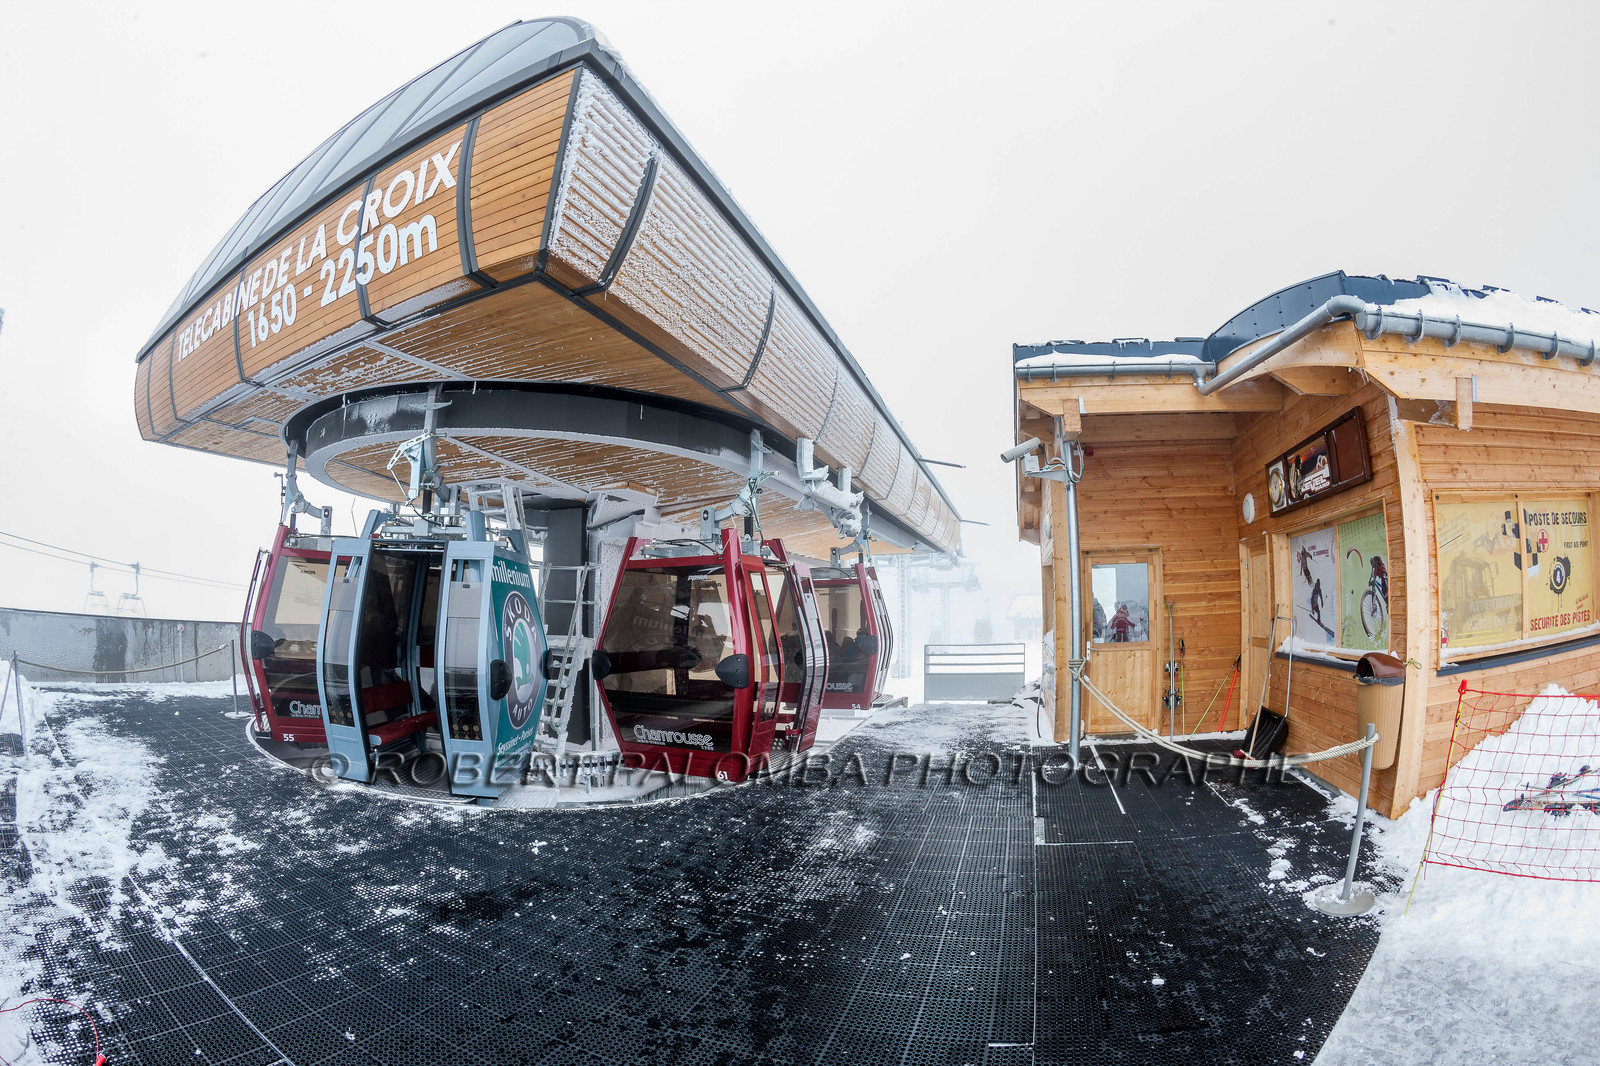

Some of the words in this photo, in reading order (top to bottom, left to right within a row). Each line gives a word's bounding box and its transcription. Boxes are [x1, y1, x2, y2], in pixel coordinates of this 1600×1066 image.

[261, 246, 293, 299] DE
[296, 223, 327, 276] LA
[336, 140, 463, 246] CROIX
[247, 283, 297, 348] 1650
[320, 214, 438, 308] 2250m
[1529, 512, 1550, 526] POSTE
[1551, 511, 1560, 525] DE
[1561, 511, 1587, 525] SECOURS
[492, 560, 530, 588] millenium
[1560, 613, 1571, 626] DES
[1572, 609, 1591, 624] PISTES
[289, 700, 322, 716] Cham
[512, 697, 533, 721] AUTO
[283, 733, 295, 742] 55
[633, 724, 714, 747] Chamrousse
[717, 770, 728, 780] 61
